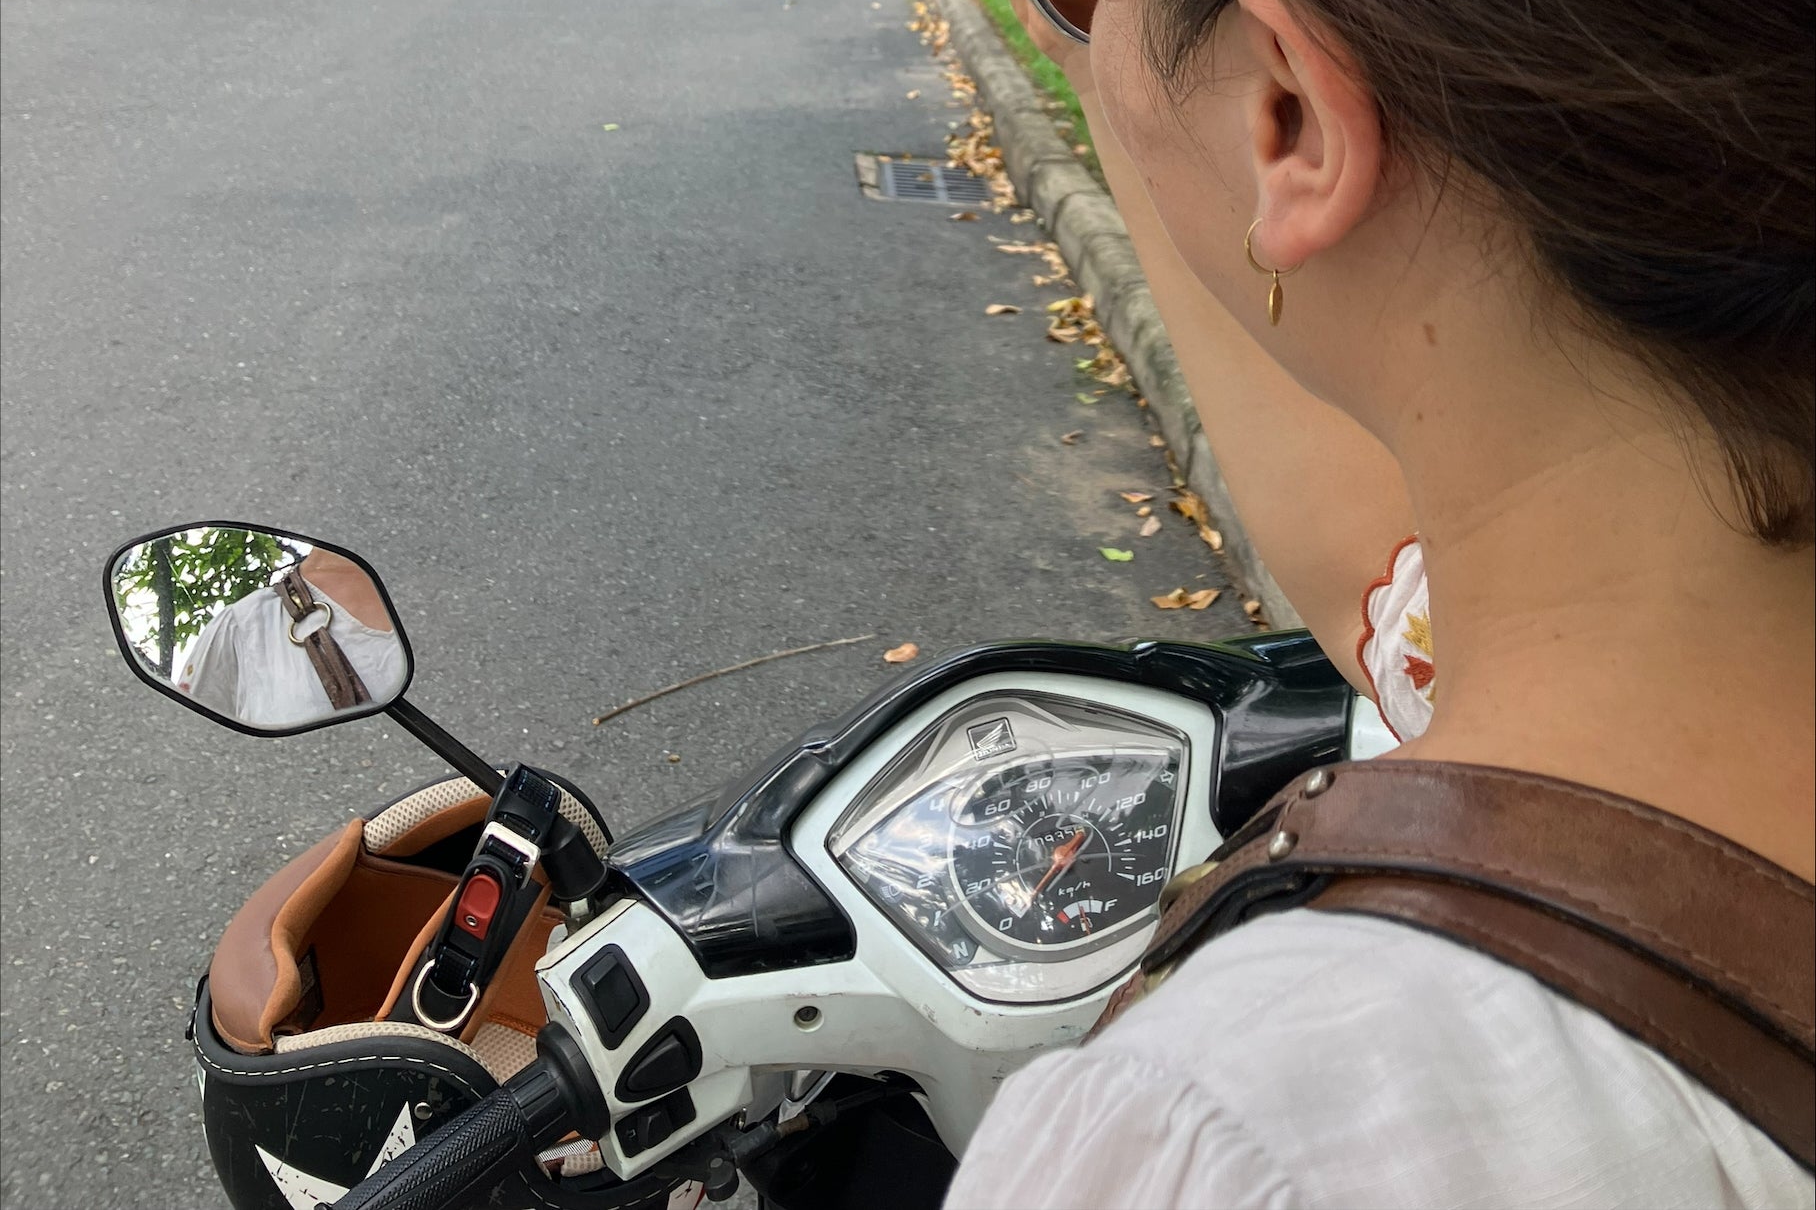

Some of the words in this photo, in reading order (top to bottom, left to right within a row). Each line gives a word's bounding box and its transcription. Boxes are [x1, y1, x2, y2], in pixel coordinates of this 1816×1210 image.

[1025, 776, 1052, 793] 80
[1081, 772, 1111, 790] 100
[929, 798, 945, 812] 4
[984, 799, 1011, 816] 60
[1115, 792, 1146, 810] 120
[1134, 824, 1168, 843] 140
[966, 835, 991, 850] 40
[1136, 867, 1166, 887] 160
[965, 878, 991, 895] 20
[1104, 898, 1118, 912] F
[933, 910, 942, 927] 1
[999, 917, 1013, 931] 0
[952, 941, 969, 959] N
